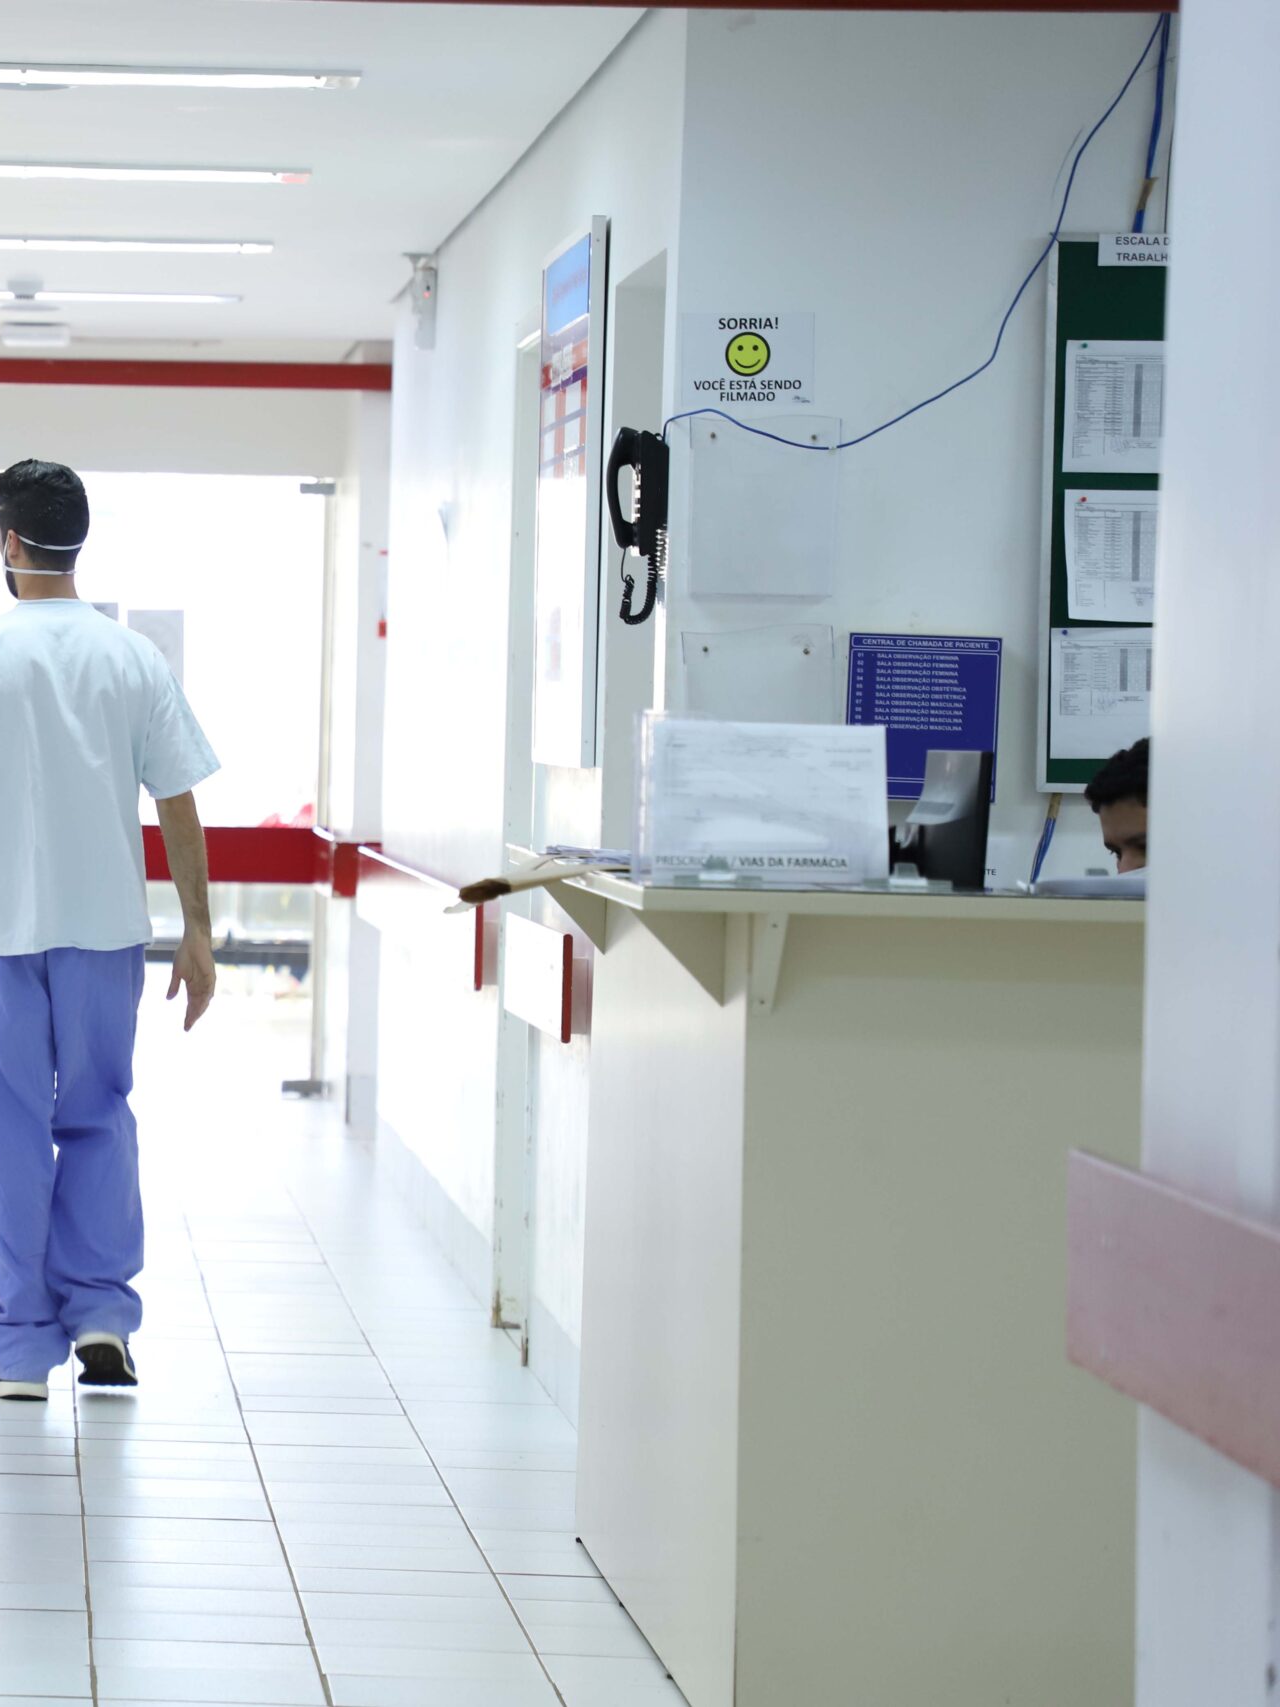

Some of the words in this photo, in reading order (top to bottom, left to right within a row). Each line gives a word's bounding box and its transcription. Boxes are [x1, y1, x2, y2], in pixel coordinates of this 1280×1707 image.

[1115, 236, 1160, 246] ESCALA
[1116, 252, 1169, 262] TRABALH
[718, 317, 779, 330] SORRIA!
[694, 378, 726, 390] VOCÊ
[729, 378, 757, 390] ESTÁ
[760, 379, 802, 390] SENDO
[719, 391, 776, 402] FILMADO
[862, 638, 895, 646] CENTRAL
[907, 640, 943, 648] CHAMADA
[955, 641, 990, 649] PACIENTE
[738, 856, 765, 868] VIAS
[768, 856, 785, 868] DA
[787, 855, 848, 869] FARMÁCIA
